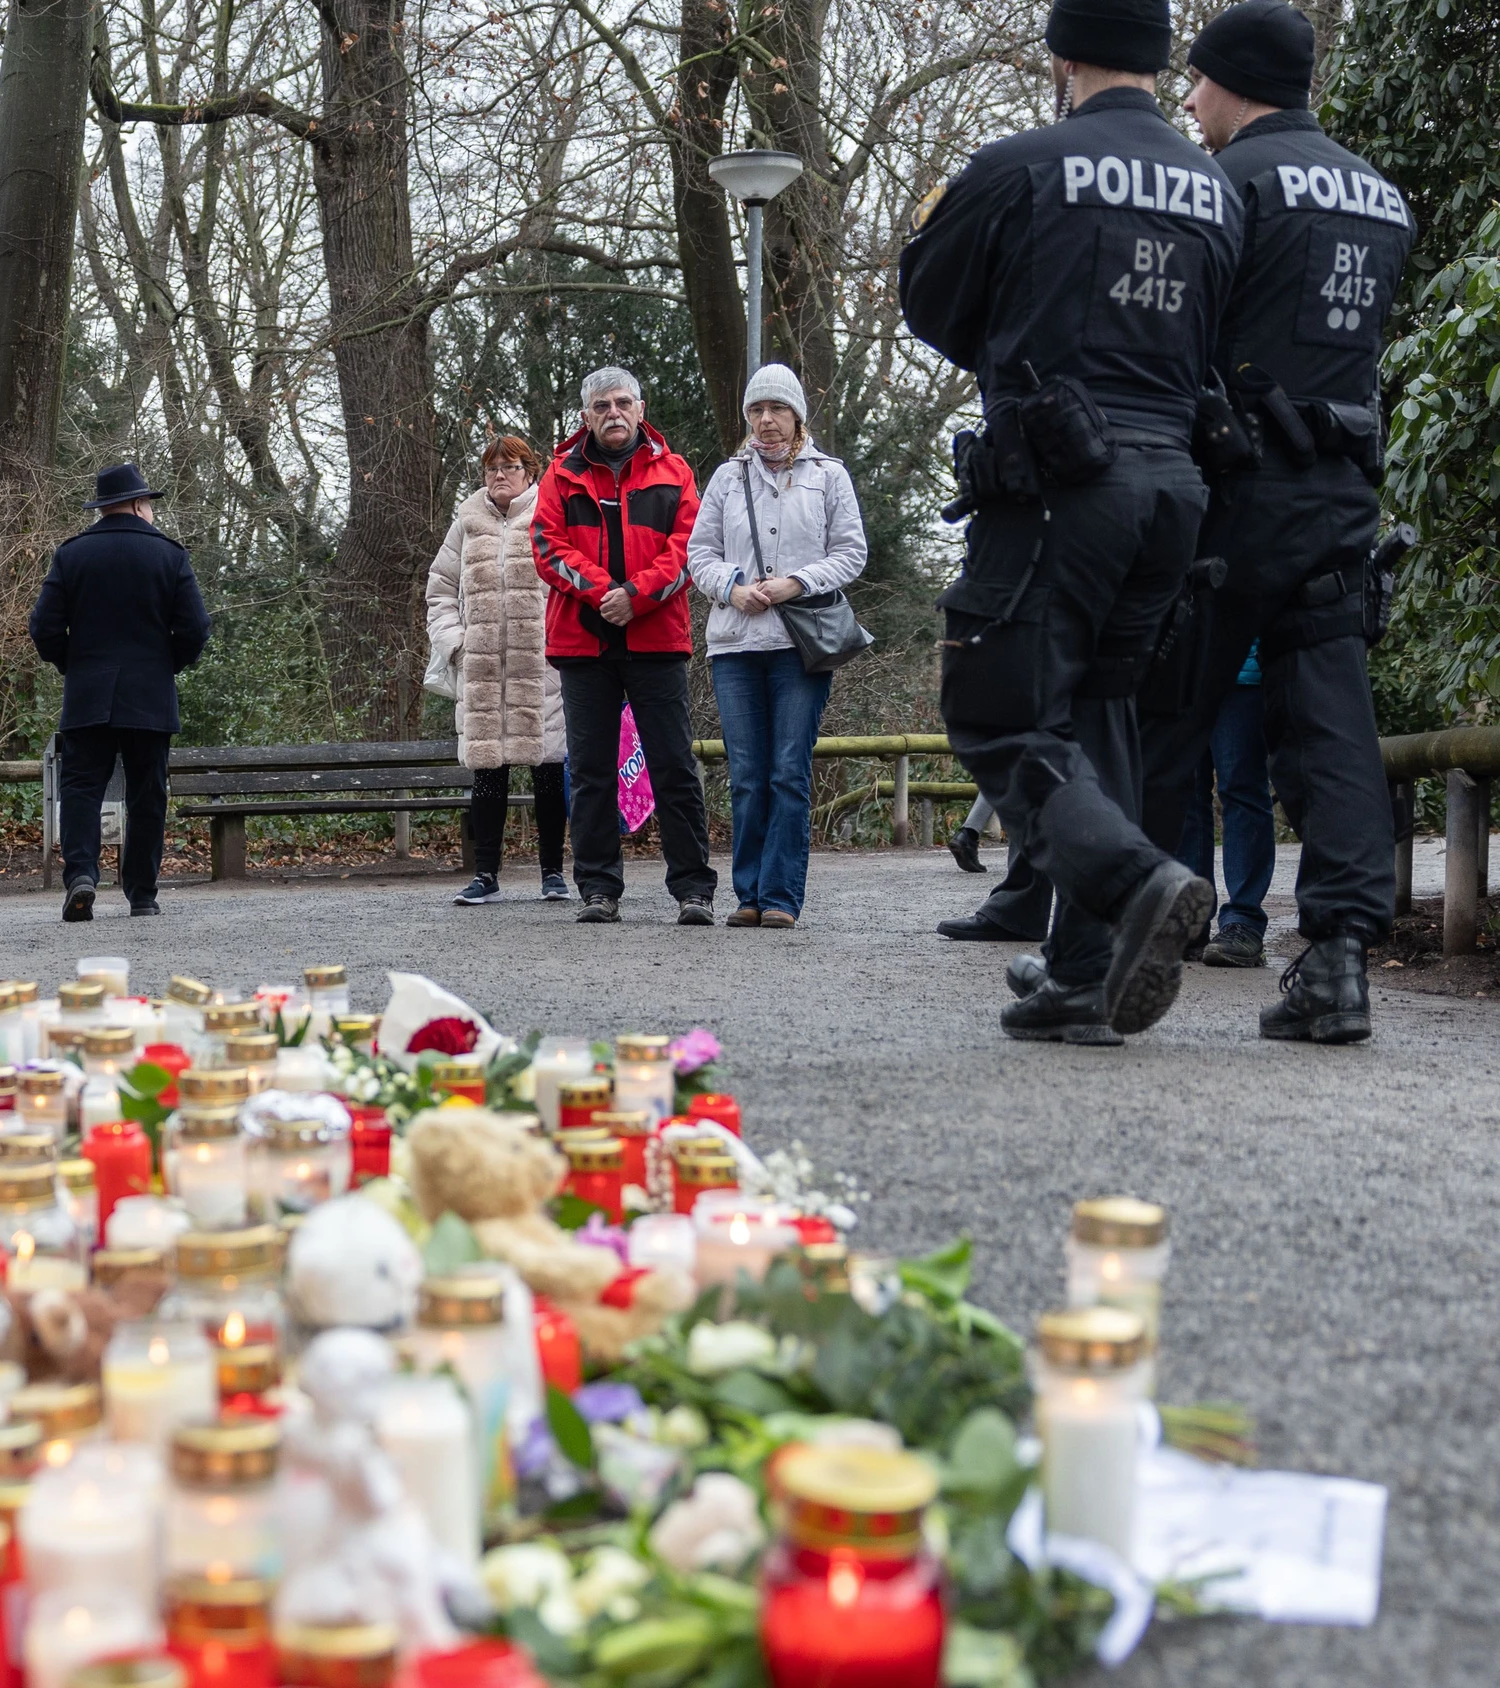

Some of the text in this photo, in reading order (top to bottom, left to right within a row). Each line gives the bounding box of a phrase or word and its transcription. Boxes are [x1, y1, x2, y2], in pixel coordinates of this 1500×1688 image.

[1063, 155, 1224, 226] POLIZEI
[1277, 165, 1409, 228] POLIZEI
[1134, 237, 1176, 275] BY
[1334, 241, 1370, 275] BY
[1108, 272, 1187, 314] 4413
[1319, 272, 1377, 308] 4413
[618, 740, 646, 789] KOD
